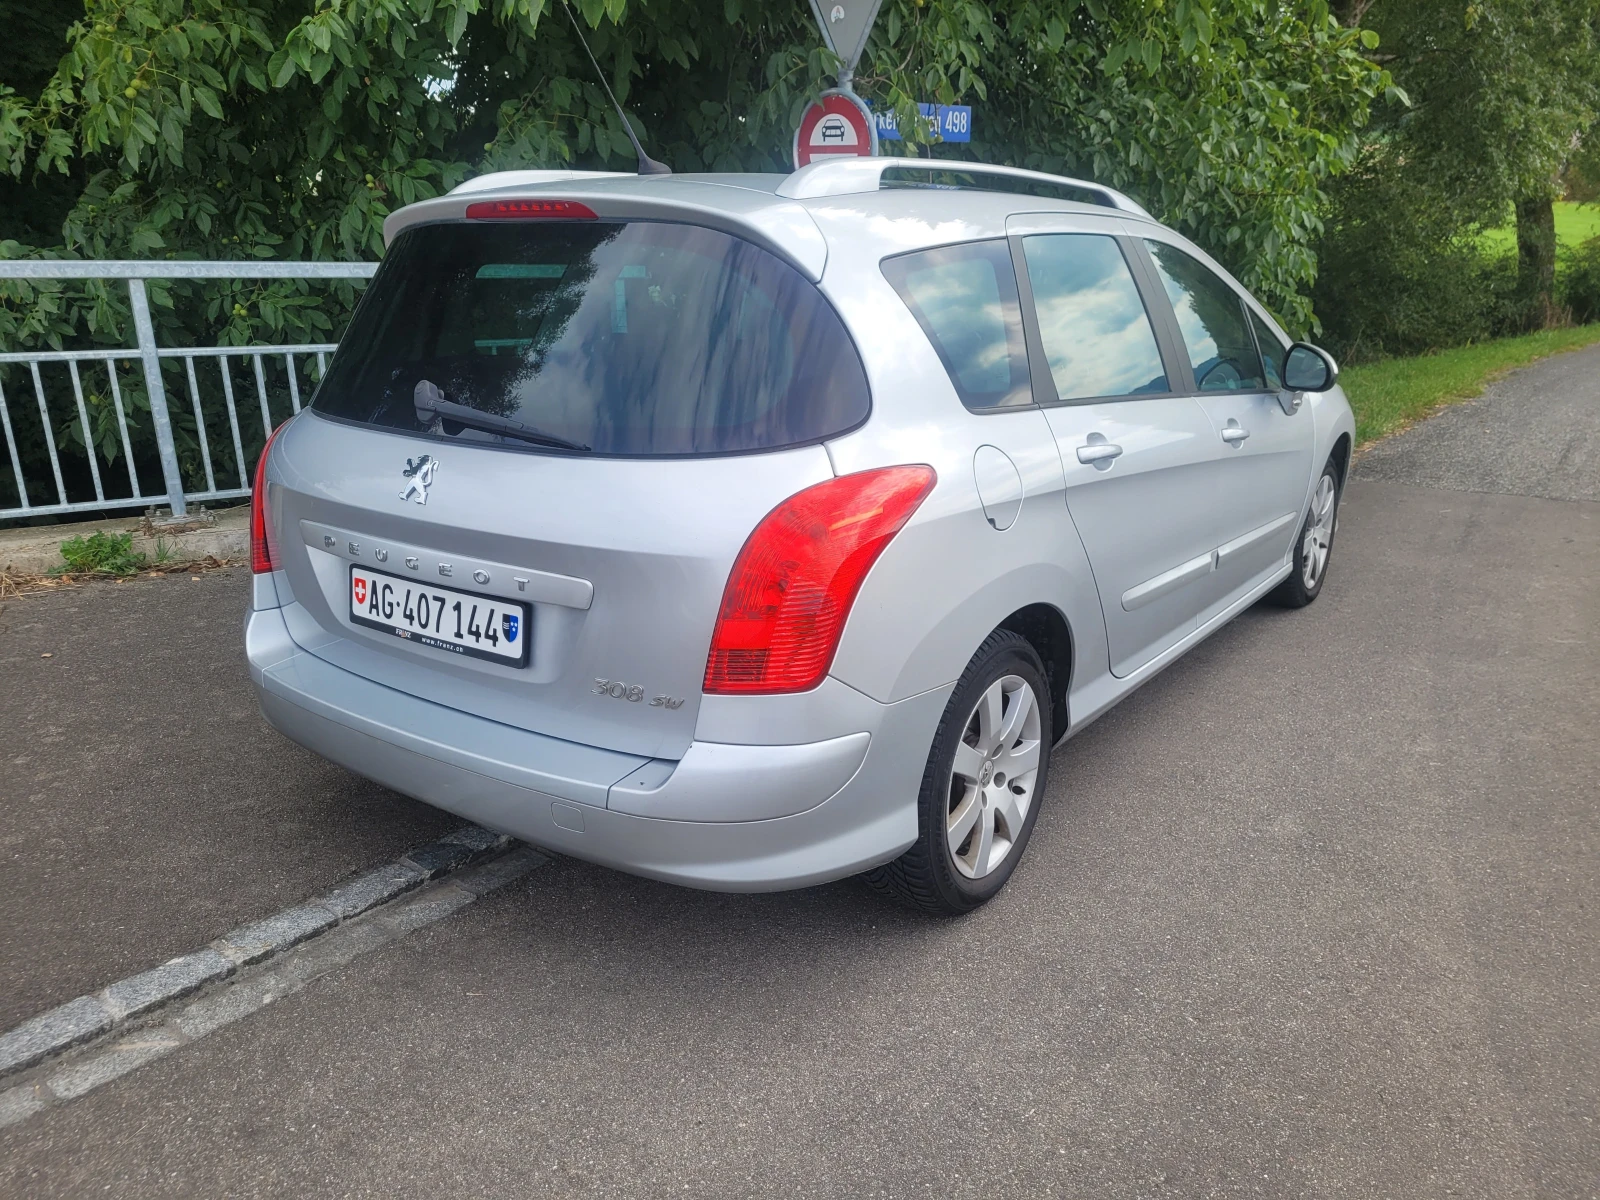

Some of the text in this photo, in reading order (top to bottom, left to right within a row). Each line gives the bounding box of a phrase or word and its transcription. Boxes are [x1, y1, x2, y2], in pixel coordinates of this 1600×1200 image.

[945, 110, 967, 133] 498
[324, 535, 530, 592] PEUGEOT
[591, 677, 645, 703] 308
